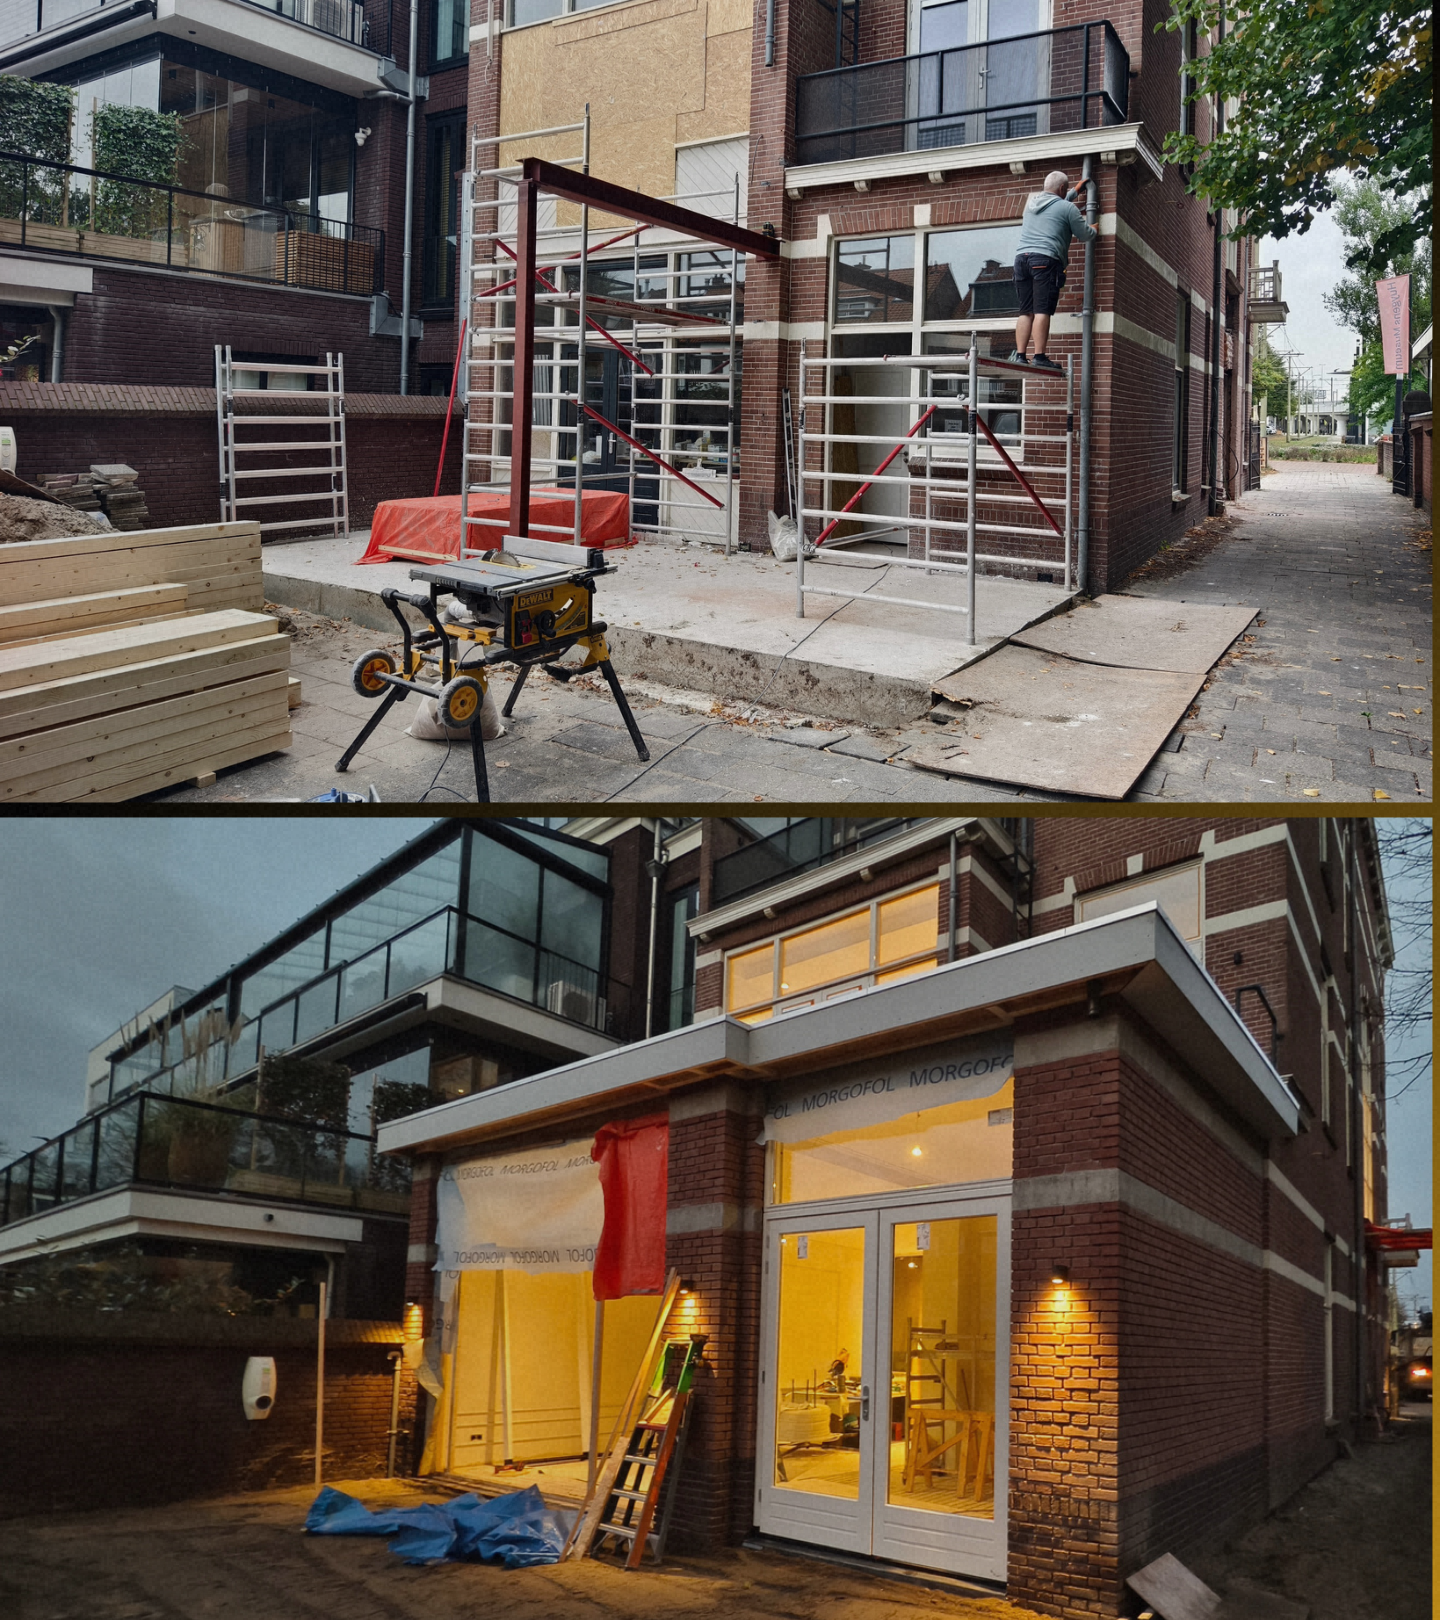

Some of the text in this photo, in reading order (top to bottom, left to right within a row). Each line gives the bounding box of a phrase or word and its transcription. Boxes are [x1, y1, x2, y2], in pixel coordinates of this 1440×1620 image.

[802, 1077, 895, 1112] MORGOFOL
[500, 1160, 558, 1175] MORGOFOL
[455, 1251, 505, 1264] MORGOFOL
[510, 1250, 560, 1264] MORGOFOL
